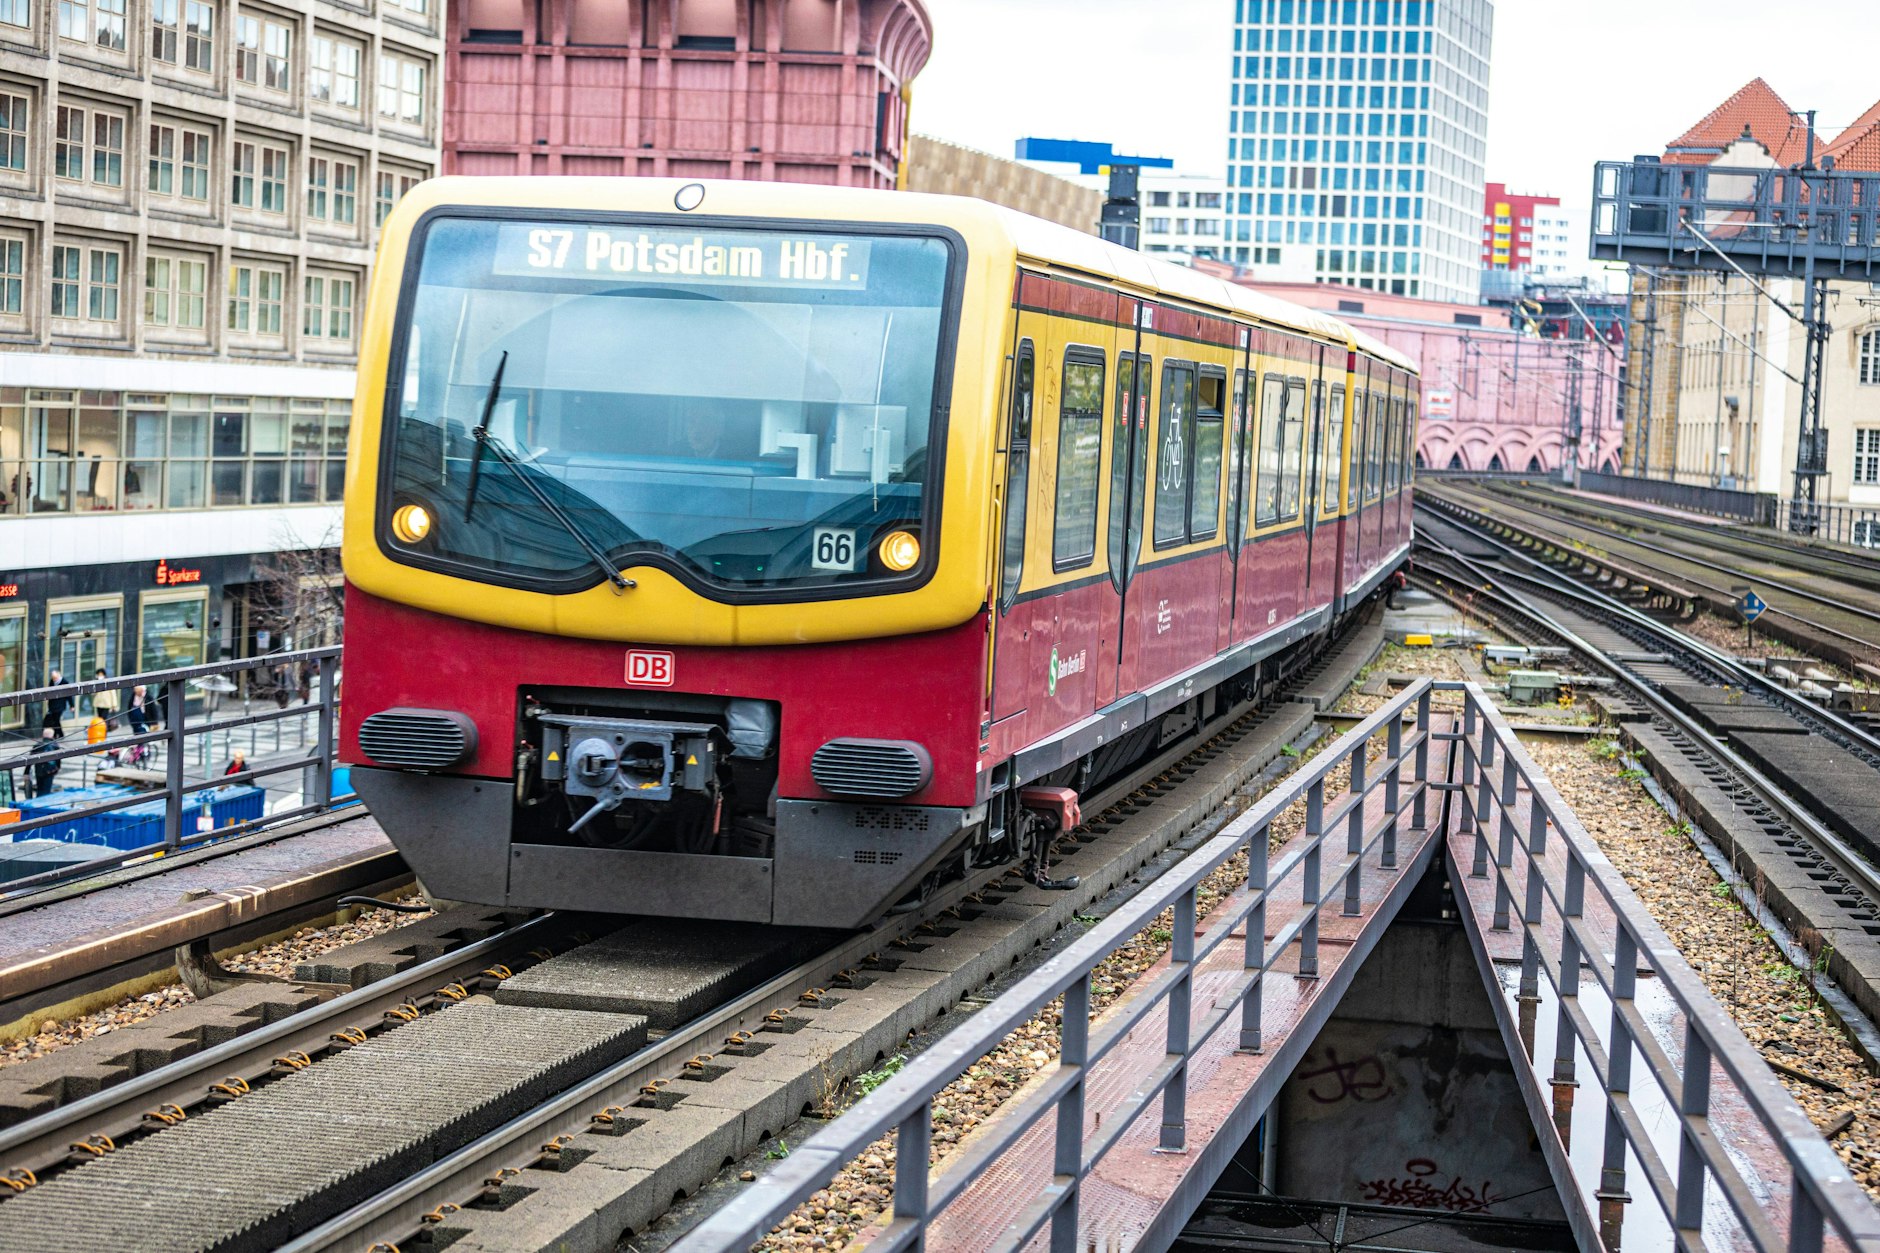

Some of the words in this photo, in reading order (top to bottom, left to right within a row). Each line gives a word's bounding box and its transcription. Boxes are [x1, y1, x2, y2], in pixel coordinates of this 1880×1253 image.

[528, 229, 574, 268] S7
[585, 231, 762, 278] Potsdam
[780, 240, 860, 281] Hbf.
[818, 532, 851, 565] 66
[168, 567, 200, 586] Sparkasse
[633, 655, 667, 679] DB
